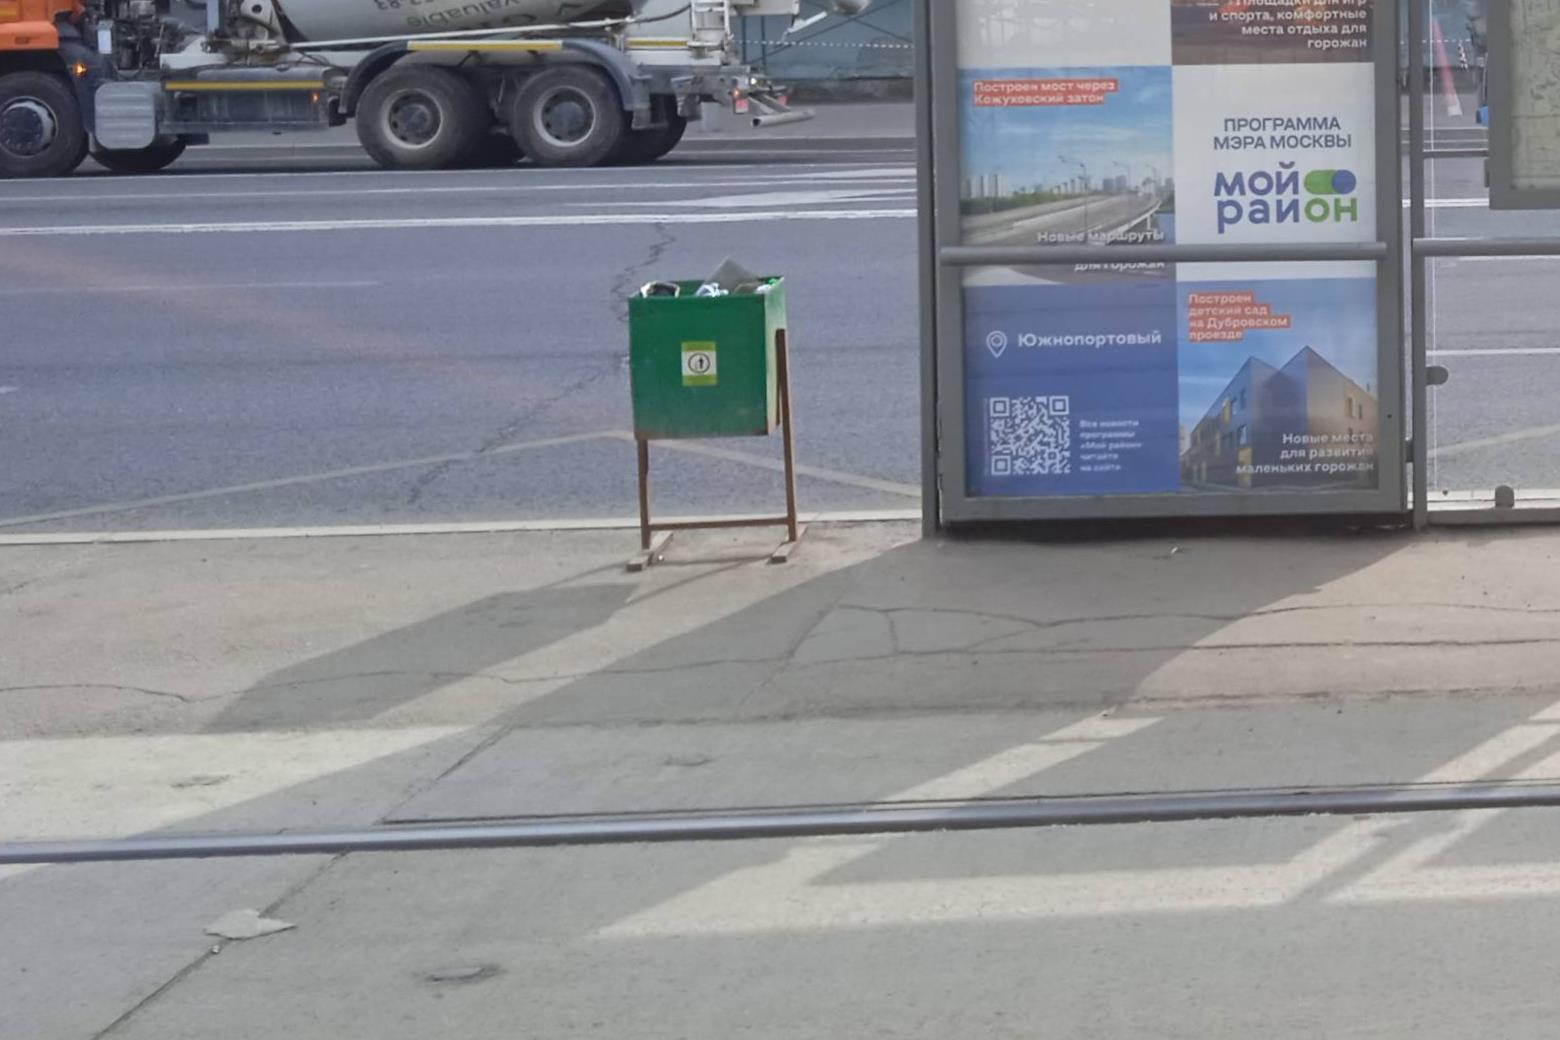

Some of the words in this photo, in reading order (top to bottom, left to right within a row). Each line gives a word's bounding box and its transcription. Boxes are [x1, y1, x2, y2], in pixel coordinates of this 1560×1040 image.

[1208, 12, 1218, 21] и
[1221, 11, 1275, 23] спорта,
[1277, 9, 1367, 22] комфортные
[1242, 25, 1284, 35] места
[1287, 24, 1338, 35] отдыха
[1341, 24, 1367, 35] для
[1307, 39, 1367, 50] горожан
[974, 81, 1038, 93] Построен
[1040, 82, 1074, 91] мост
[1075, 81, 1115, 92] через
[974, 93, 1064, 106] Кожуховский
[1067, 94, 1104, 103] затон
[1224, 116, 1341, 132] ПРОГРАММА
[1213, 135, 1266, 150] МЭРА
[1270, 134, 1352, 149] МОСКВЫ
[1214, 161, 1299, 196] мой
[1037, 231, 1085, 242] Новые
[1088, 230, 1164, 243] маршруты
[1188, 293, 1252, 305] Построен
[1189, 306, 1242, 316] детский
[1244, 306, 1268, 315] сад
[1207, 317, 1288, 329] Дубровском
[1018, 330, 1162, 348] Южнопортовый
[1189, 331, 1243, 341] проезде
[1282, 433, 1328, 444] Новые
[1332, 433, 1374, 443] места
[1280, 449, 1306, 459] для
[1309, 448, 1374, 459] развития
[1235, 463, 1312, 474] маленьких
[1314, 462, 1374, 474] горожан
